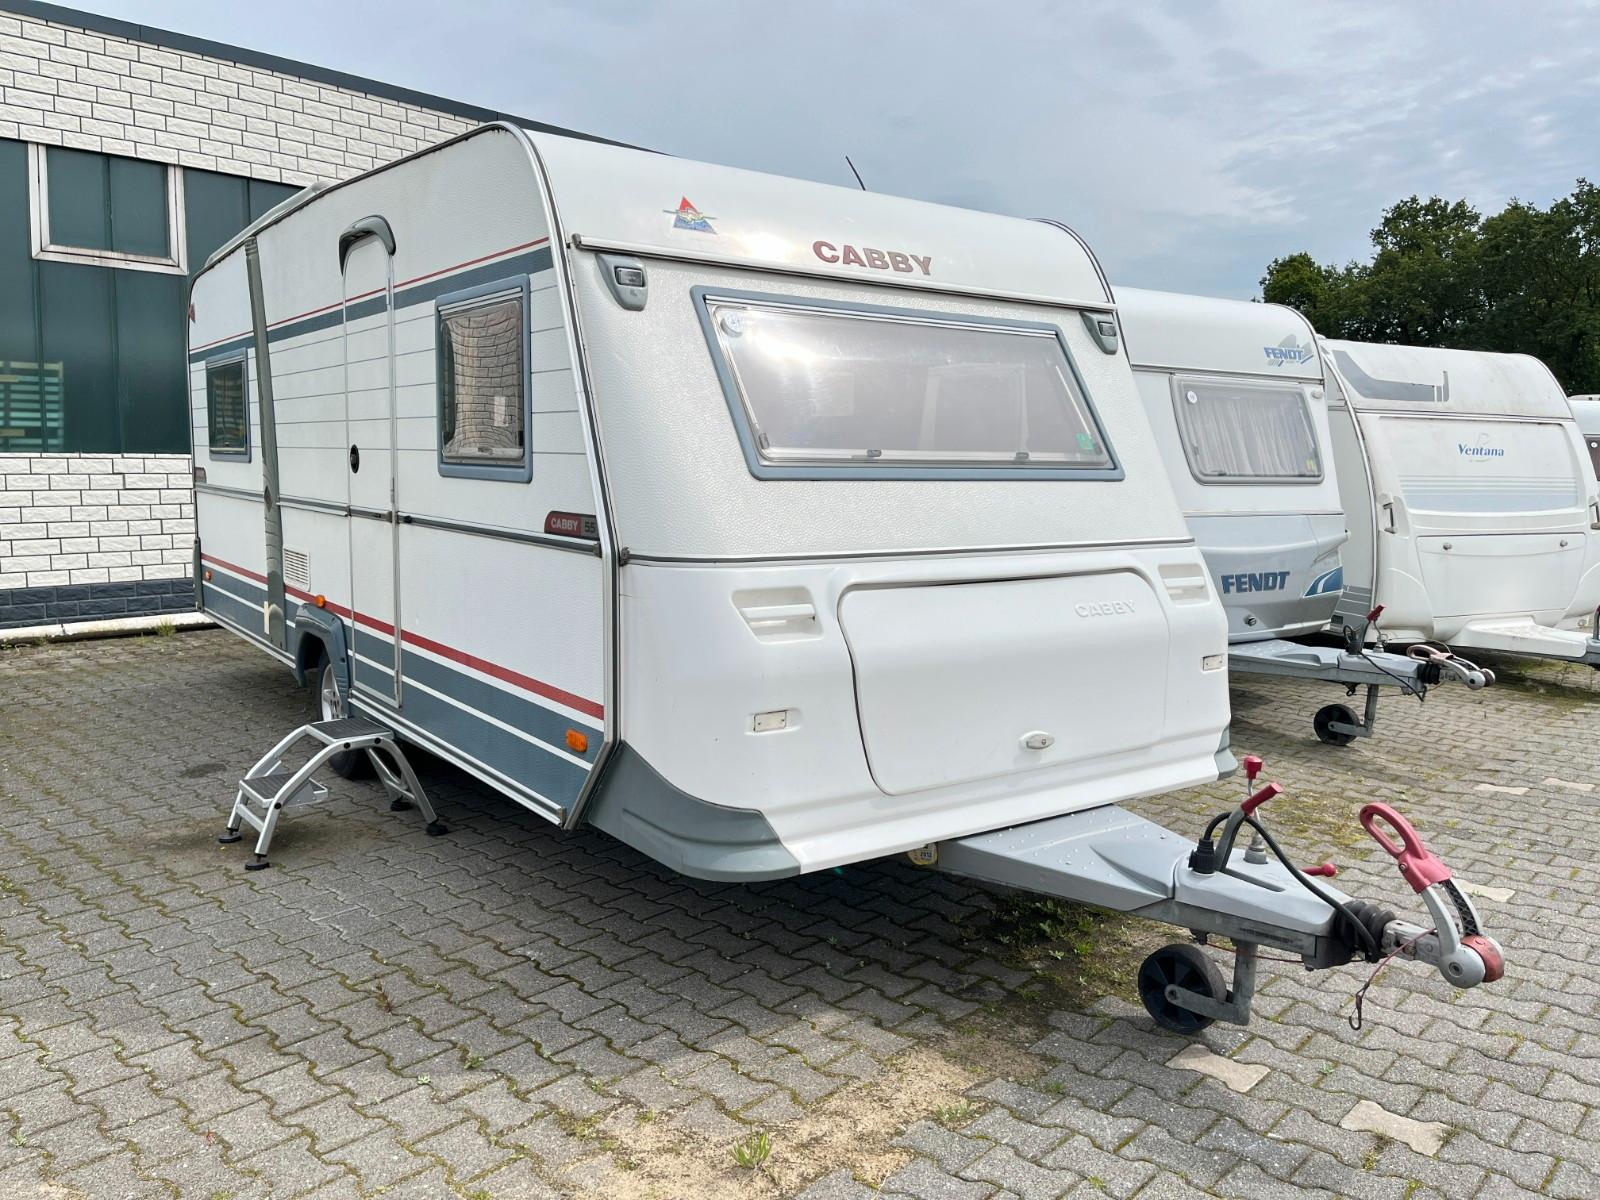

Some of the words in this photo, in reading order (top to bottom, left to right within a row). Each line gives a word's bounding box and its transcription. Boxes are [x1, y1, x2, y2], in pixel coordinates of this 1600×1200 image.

[812, 240, 932, 276] CABBY
[1264, 347, 1303, 361] FENDT
[1458, 443, 1505, 457] Ventana
[550, 518, 579, 532] CABBY
[1221, 571, 1290, 594] FENDT
[1074, 600, 1136, 618] CABBY
